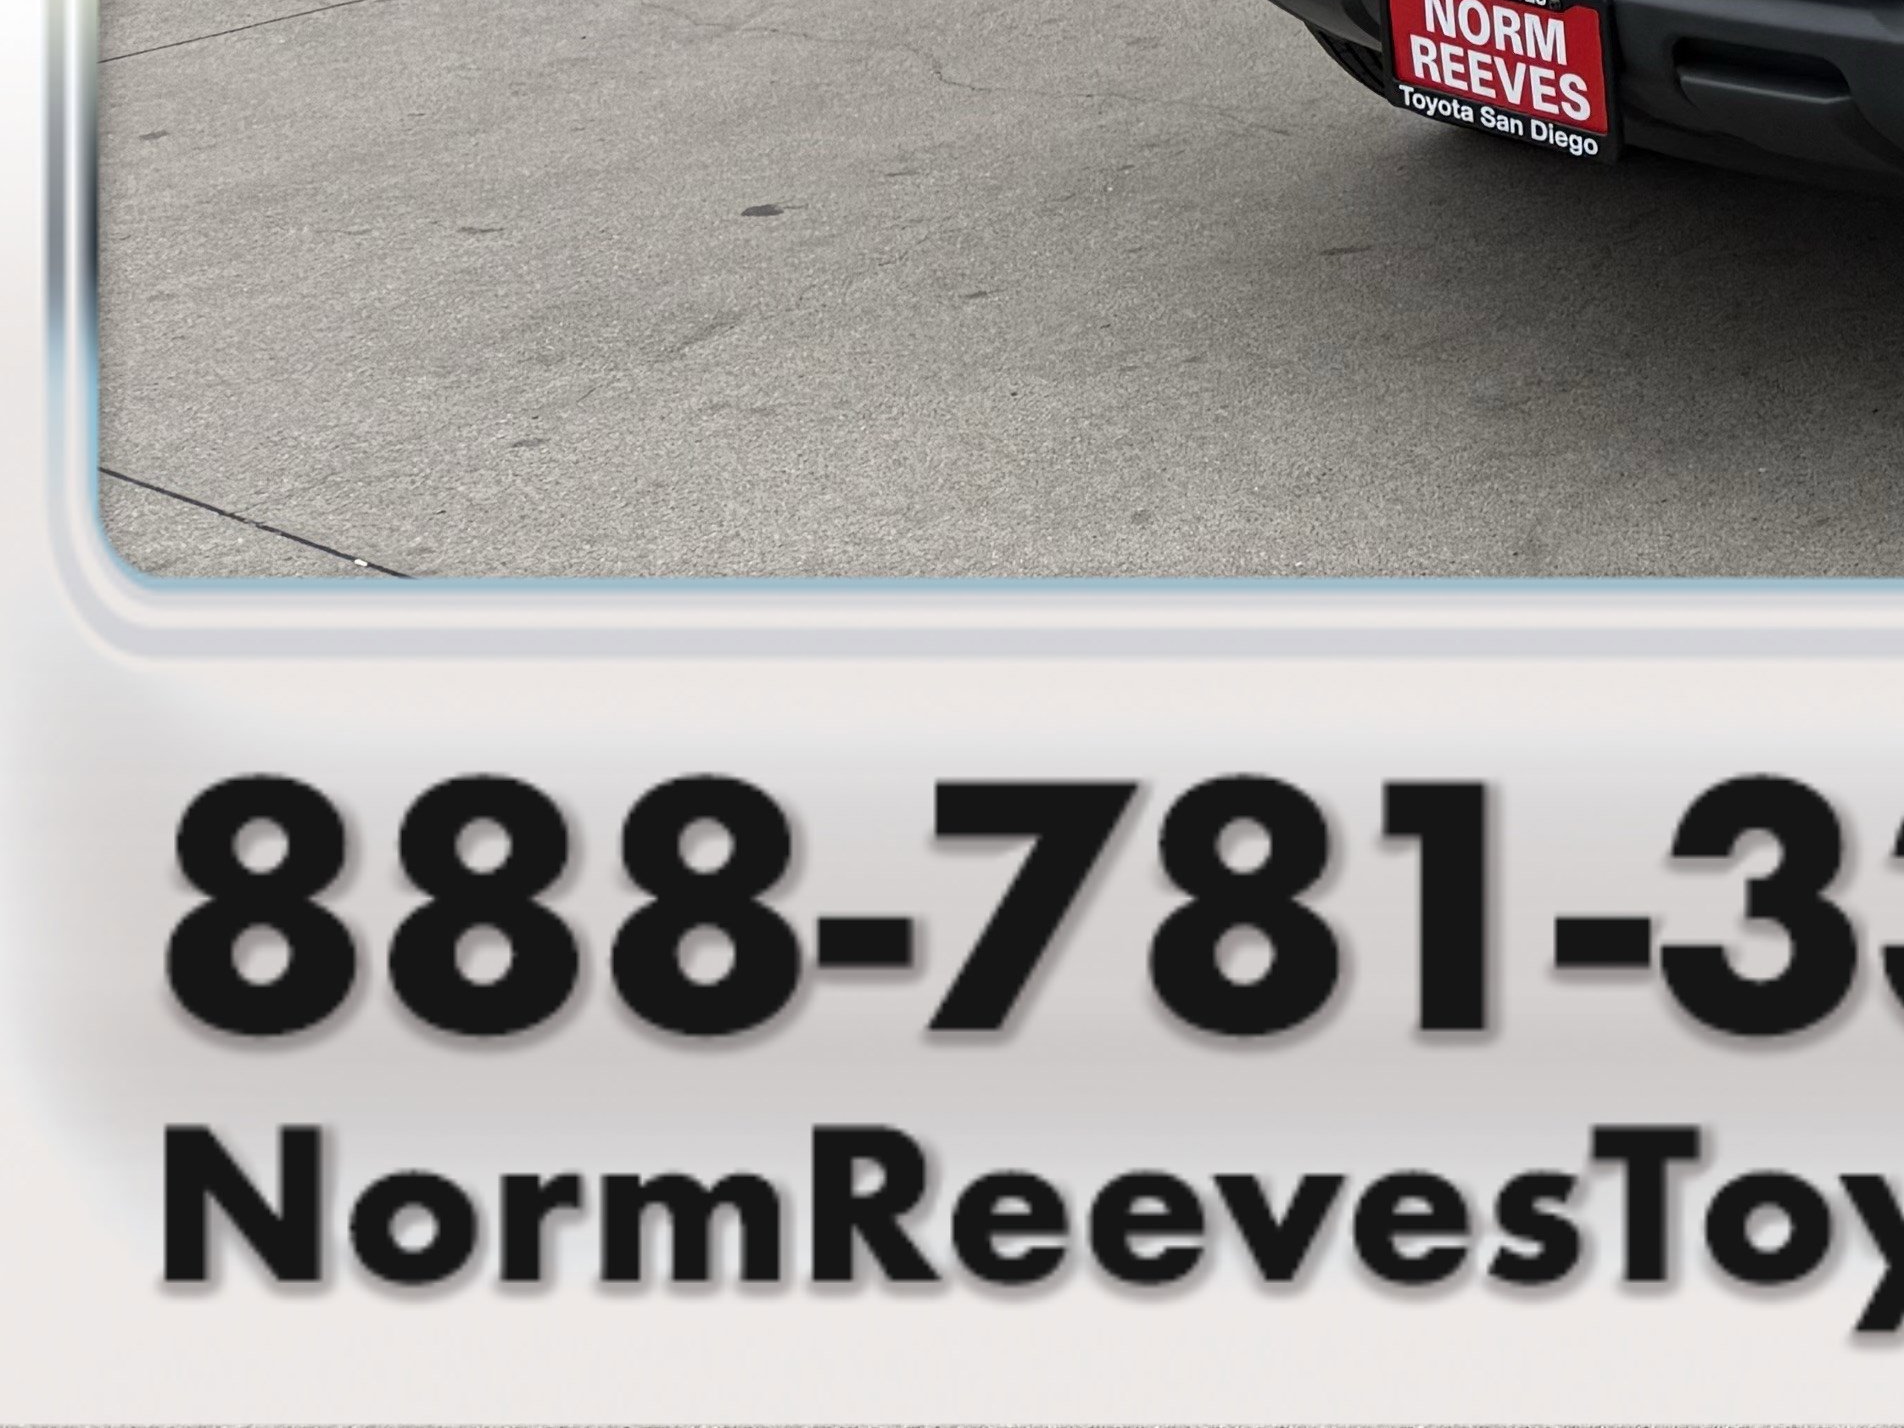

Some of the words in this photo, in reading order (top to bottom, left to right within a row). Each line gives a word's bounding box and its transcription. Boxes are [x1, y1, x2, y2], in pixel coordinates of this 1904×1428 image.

[1410, 34, 1591, 121] REEVES
[1399, 84, 1474, 123] Toyota
[1480, 106, 1524, 136] San
[1530, 119, 1599, 156] Diego
